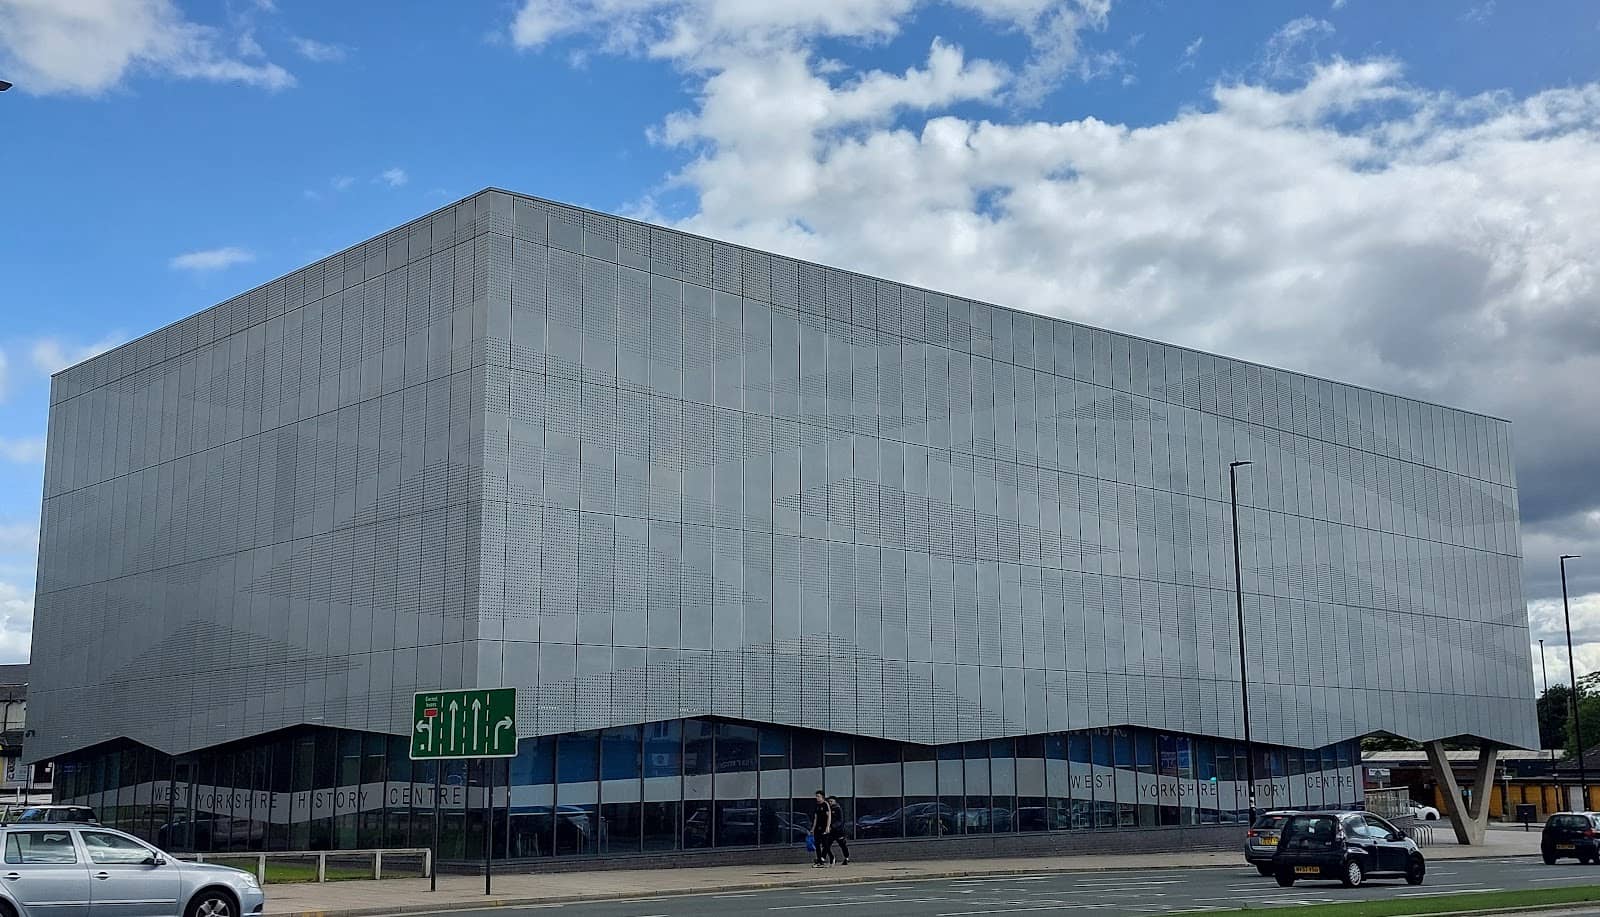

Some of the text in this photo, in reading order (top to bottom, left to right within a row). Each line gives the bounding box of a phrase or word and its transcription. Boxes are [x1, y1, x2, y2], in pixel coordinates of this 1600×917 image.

[154, 786, 461, 809] WEST YORKSHIRE HSTORY CENTRE
[1070, 774, 1353, 798] WEST YORKSHRE HITORY CENTRE
